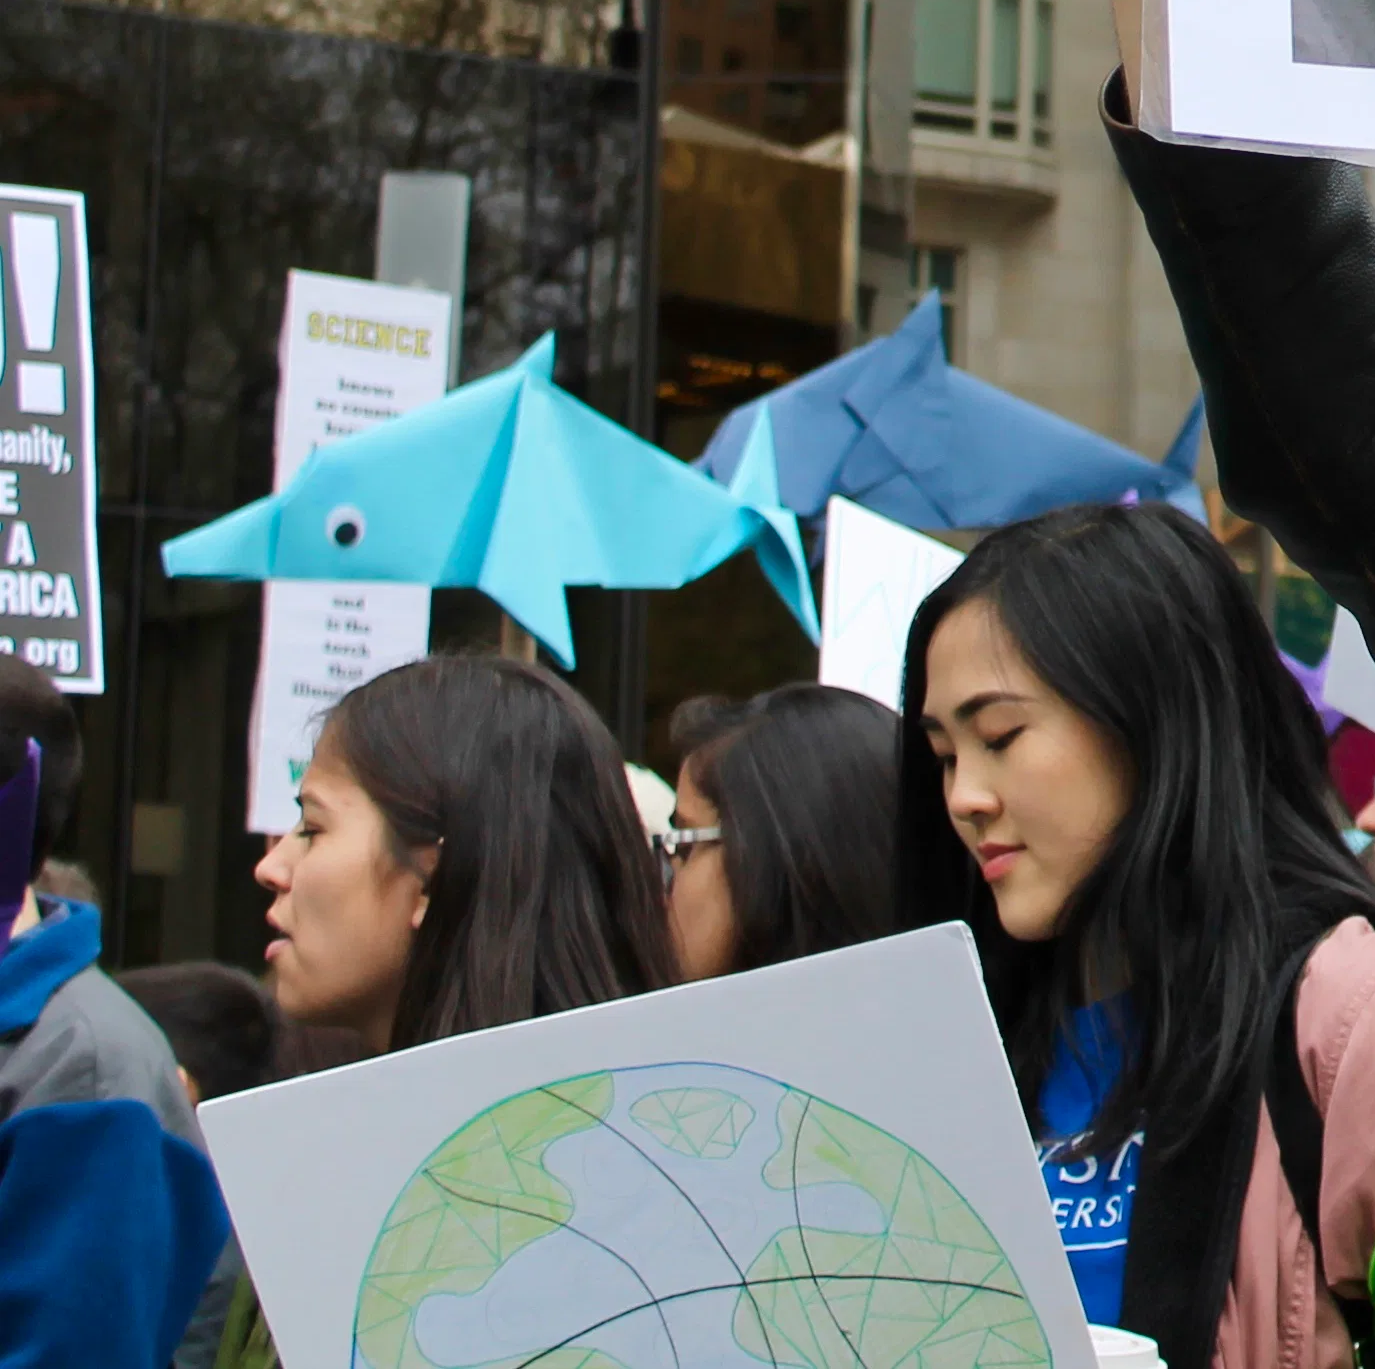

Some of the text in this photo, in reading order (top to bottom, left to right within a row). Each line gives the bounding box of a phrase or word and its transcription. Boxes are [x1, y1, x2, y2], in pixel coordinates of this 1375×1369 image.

[307, 311, 432, 358] SCIENCE
[0, 423, 72, 474] anity,
[7, 521, 36, 566] A
